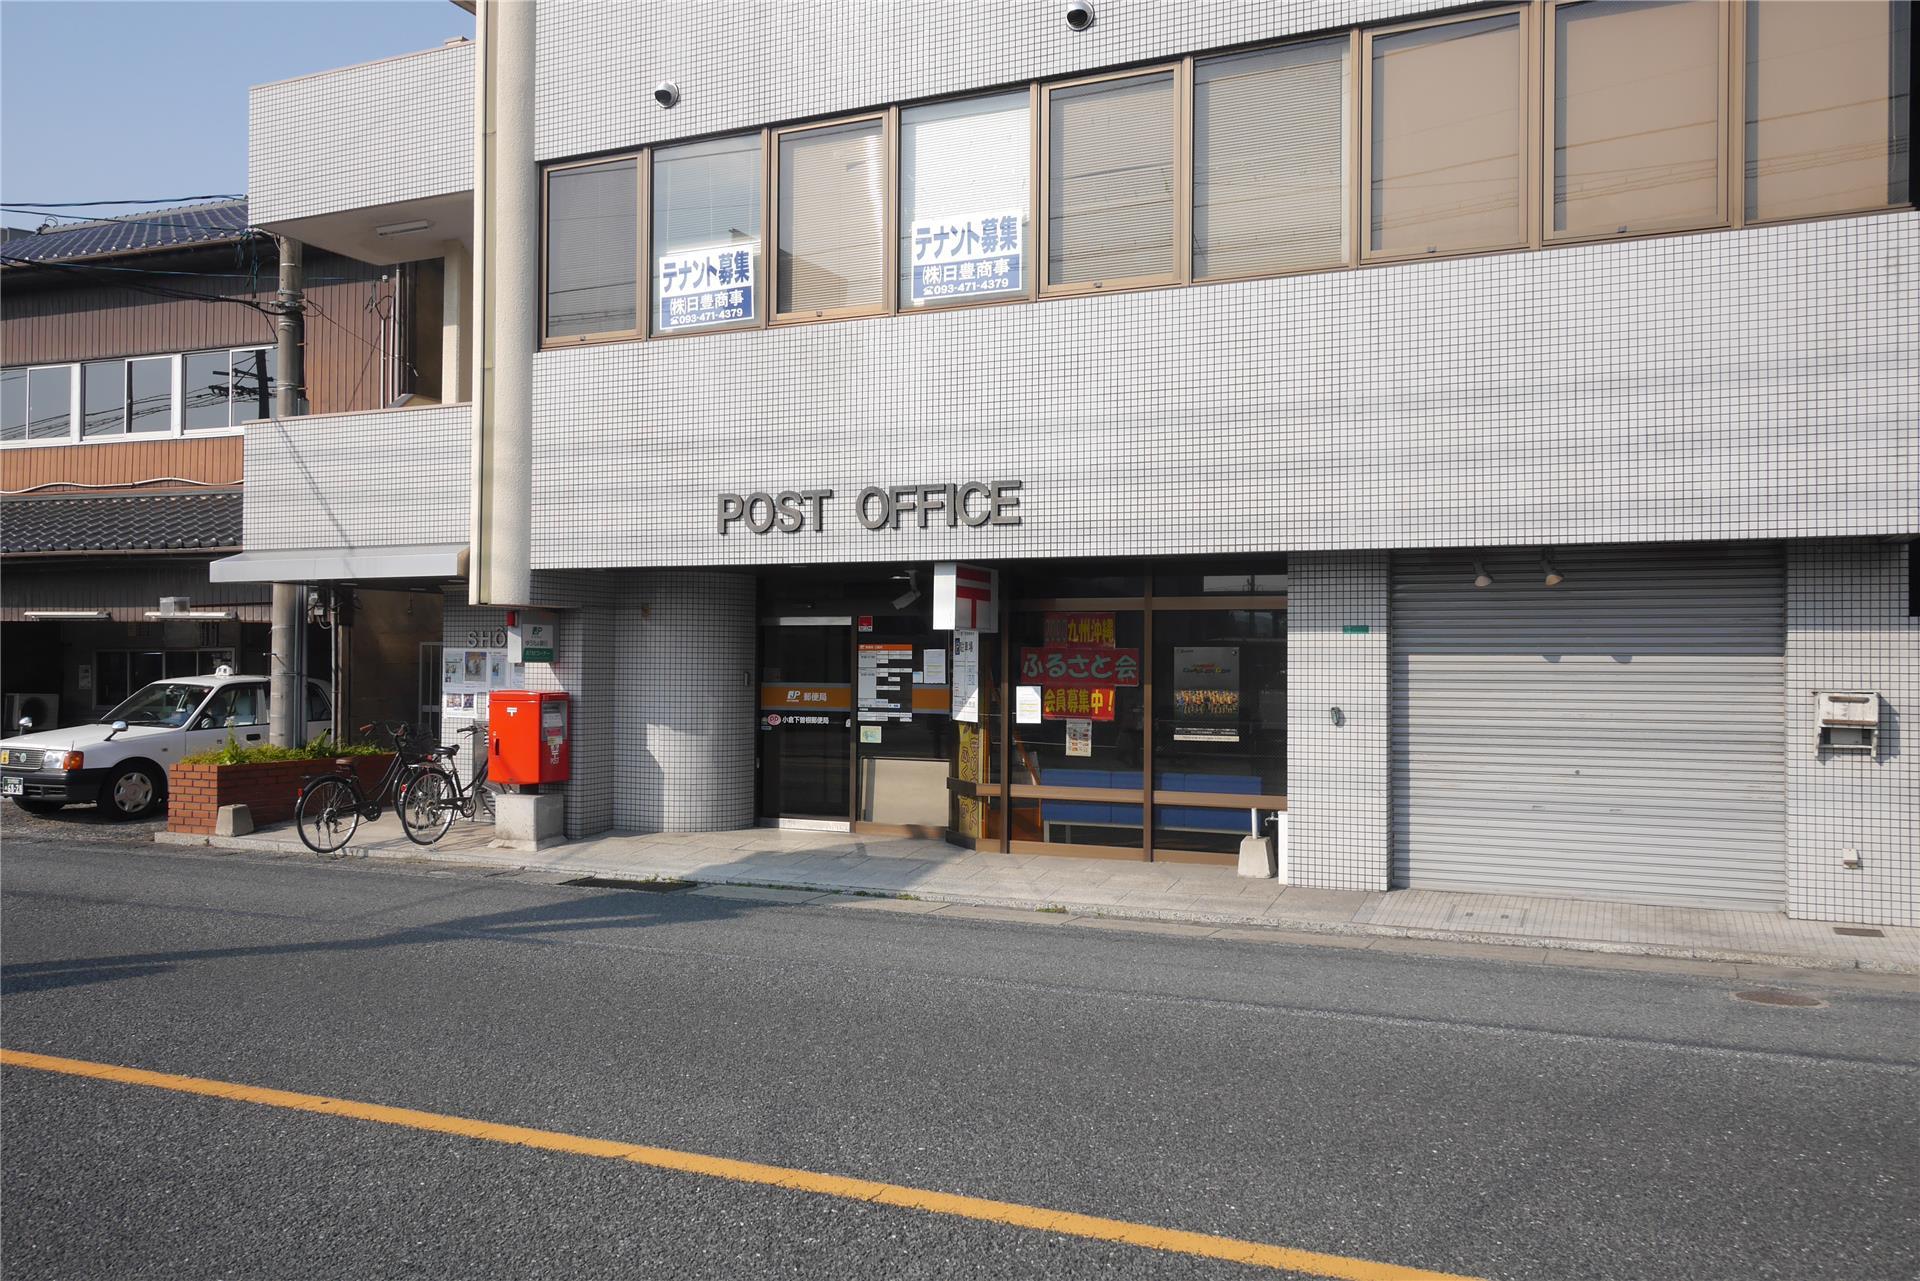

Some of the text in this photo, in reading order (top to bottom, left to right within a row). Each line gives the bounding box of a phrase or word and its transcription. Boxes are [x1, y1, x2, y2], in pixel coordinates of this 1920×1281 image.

[915, 215, 1018, 261] テナント募集
[663, 250, 750, 293] テナント募集
[680, 308, 743, 324] 093-471-4379
[717, 479, 1023, 535] POST OFFICE
[1067, 618, 1114, 644] 九州沖縄
[1023, 653, 1137, 680] ふるさと会
[803, 692, 827, 702] 郵便局
